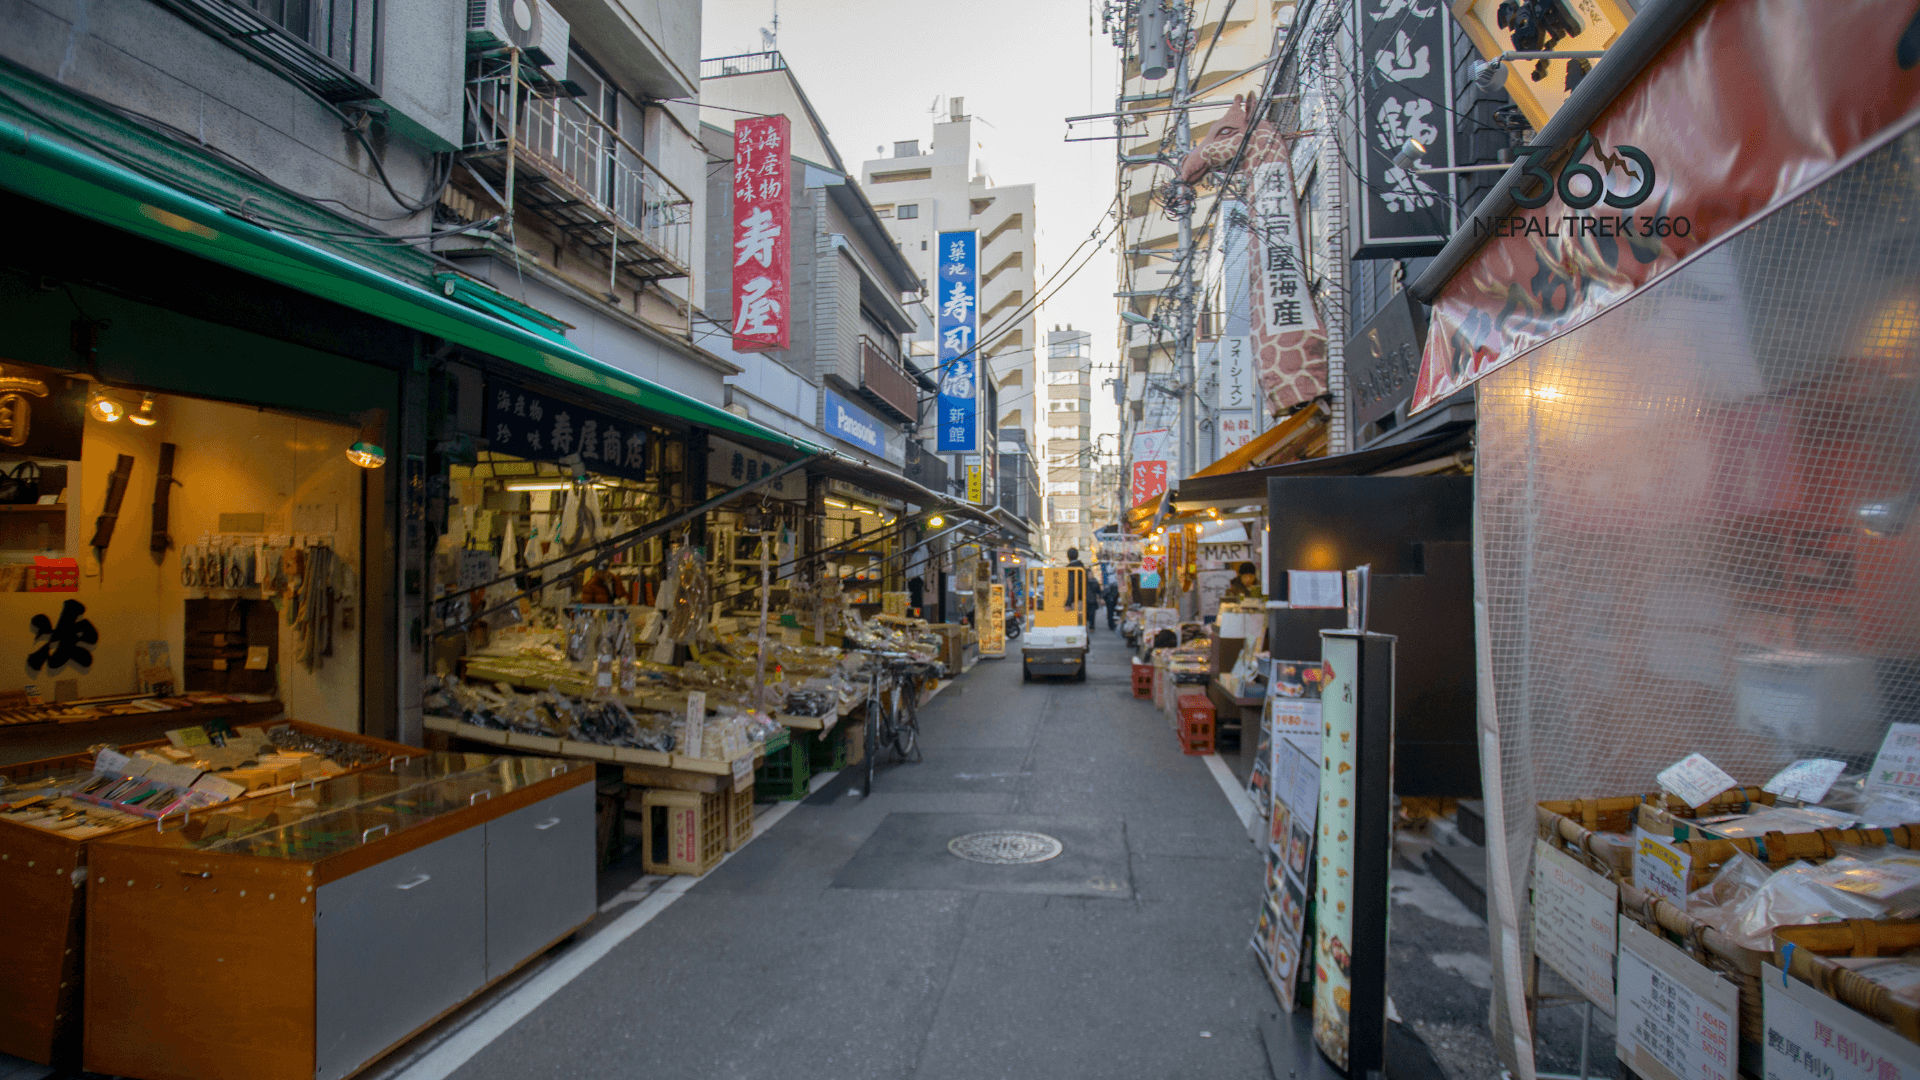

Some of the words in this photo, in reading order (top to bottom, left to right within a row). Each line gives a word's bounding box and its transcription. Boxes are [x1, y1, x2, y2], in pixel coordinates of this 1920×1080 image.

[735, 127, 757, 203] 出汁珍味
[758, 126, 782, 201] 海産物
[733, 207, 783, 336] 寿屋
[948, 241, 967, 276] 築地
[941, 282, 974, 400] 寿司清
[1230, 339, 1243, 406] フォーシーズン
[550, 410, 646, 470] 寿屋商店
[837, 405, 877, 447] Panasonic
[948, 407, 966, 444] 新館
[1205, 543, 1253, 560] MART
